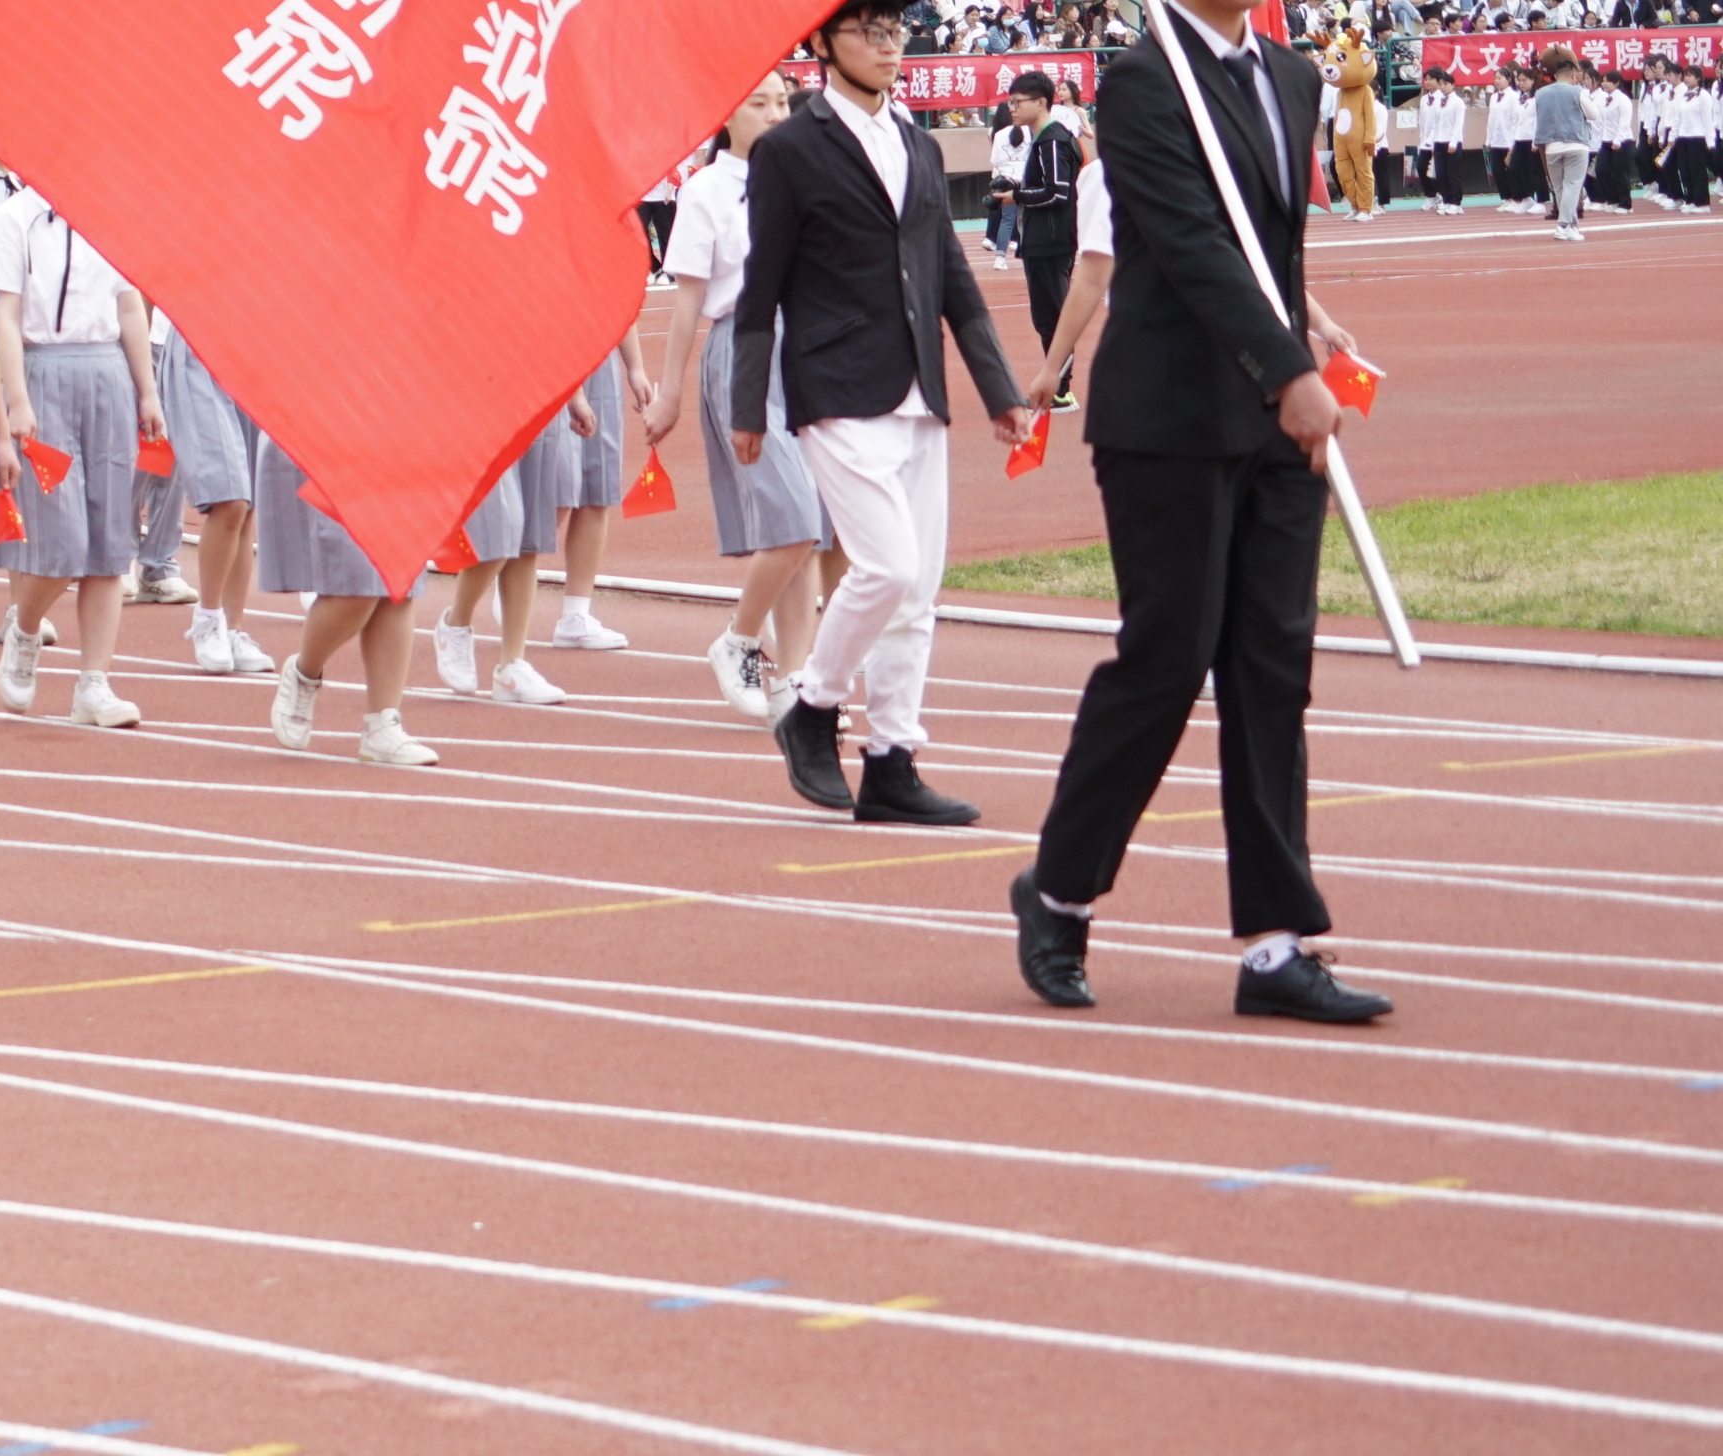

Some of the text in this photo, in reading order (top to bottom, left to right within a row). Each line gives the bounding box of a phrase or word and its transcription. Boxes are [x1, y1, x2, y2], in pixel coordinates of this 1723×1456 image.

[1445, 35, 1723, 76] 人文社学院预祝
[995, 61, 1083, 96] 食最强
